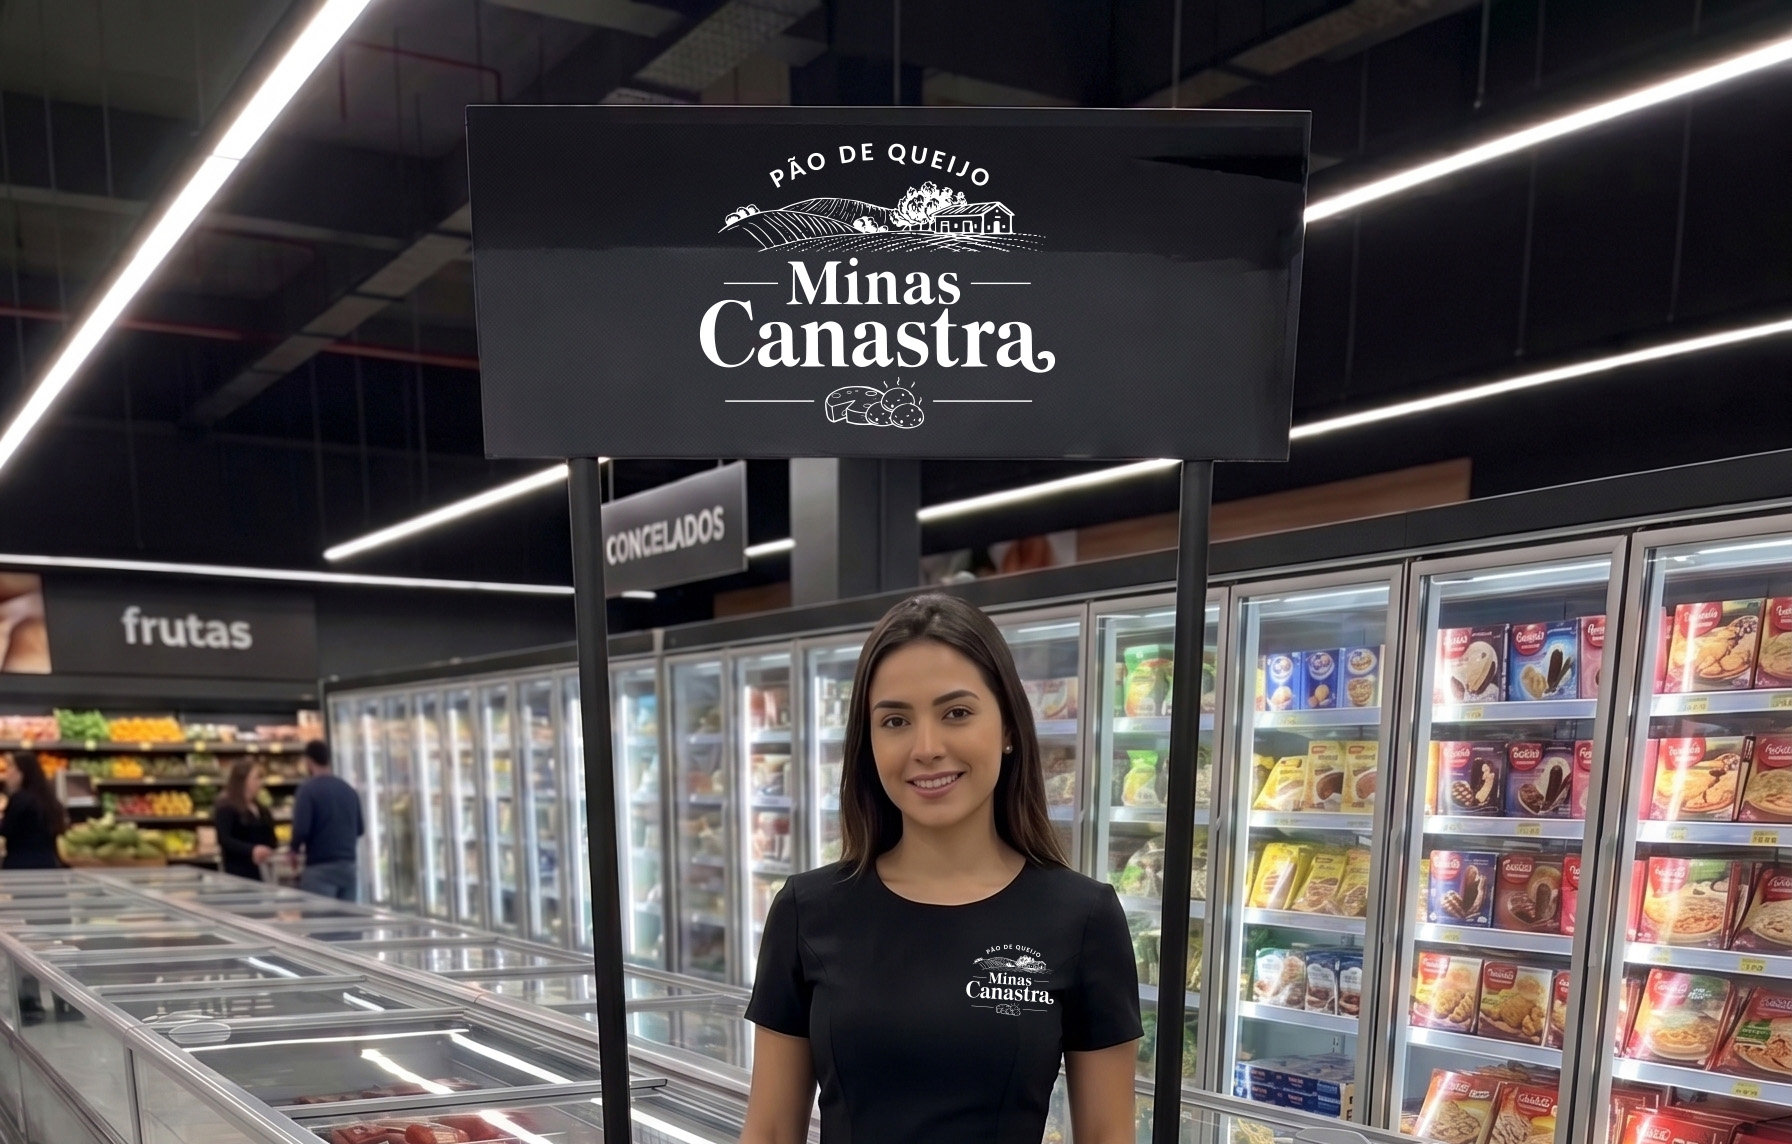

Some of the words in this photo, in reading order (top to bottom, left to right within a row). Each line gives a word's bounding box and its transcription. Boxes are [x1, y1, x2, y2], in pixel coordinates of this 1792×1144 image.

[769, 152, 826, 188] PÃO
[838, 143, 874, 164] DE
[887, 143, 990, 187] QUEIJO
[786, 257, 961, 305] Minas
[699, 299, 1056, 374] Canastra
[121, 606, 252, 649] frutas
[1015, 944, 1041, 958] QUEIJO
[966, 980, 1055, 1005] Canastra
[988, 972, 1032, 986] Minas
